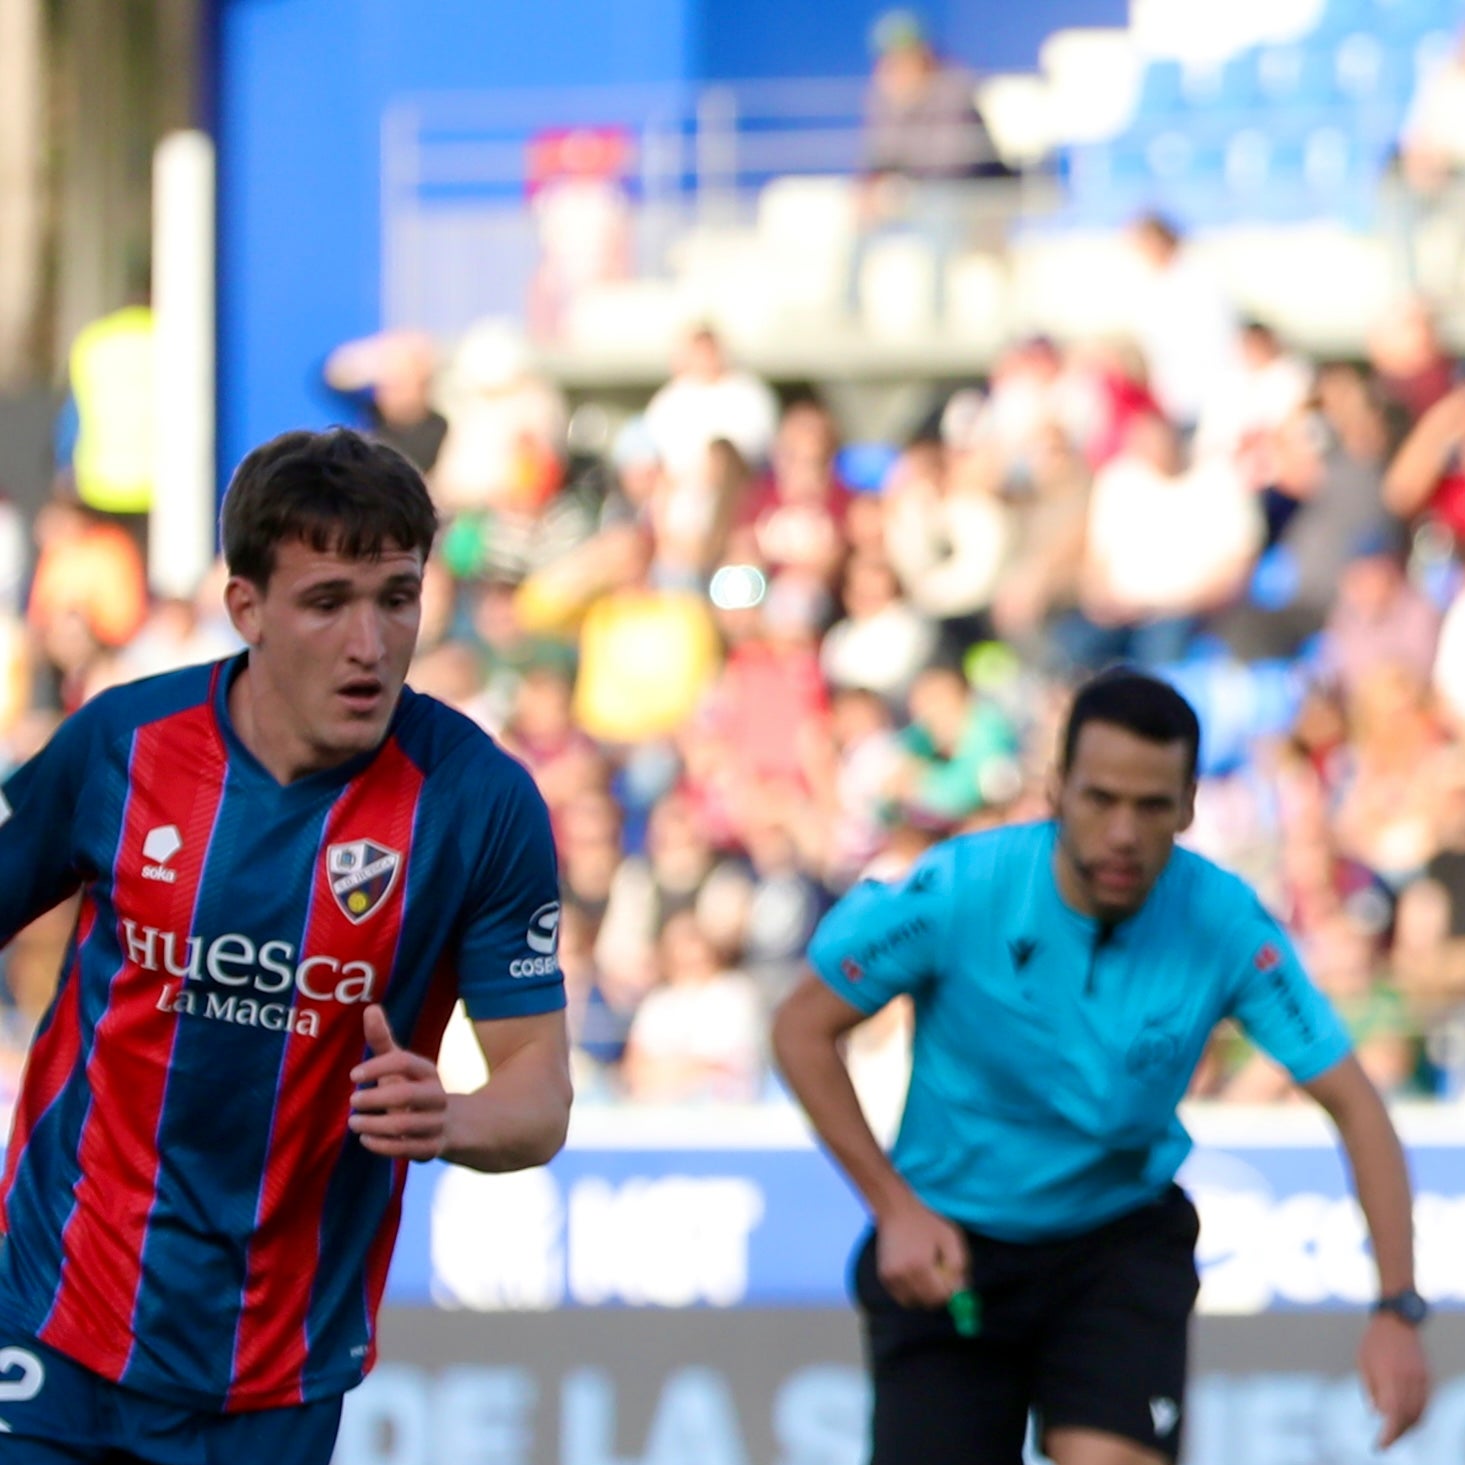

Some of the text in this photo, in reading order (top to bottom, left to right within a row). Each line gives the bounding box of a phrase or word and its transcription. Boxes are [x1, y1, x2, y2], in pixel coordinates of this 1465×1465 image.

[141, 865, 176, 883] soka
[122, 918, 377, 1005] Huesca
[155, 983, 196, 1016] La
